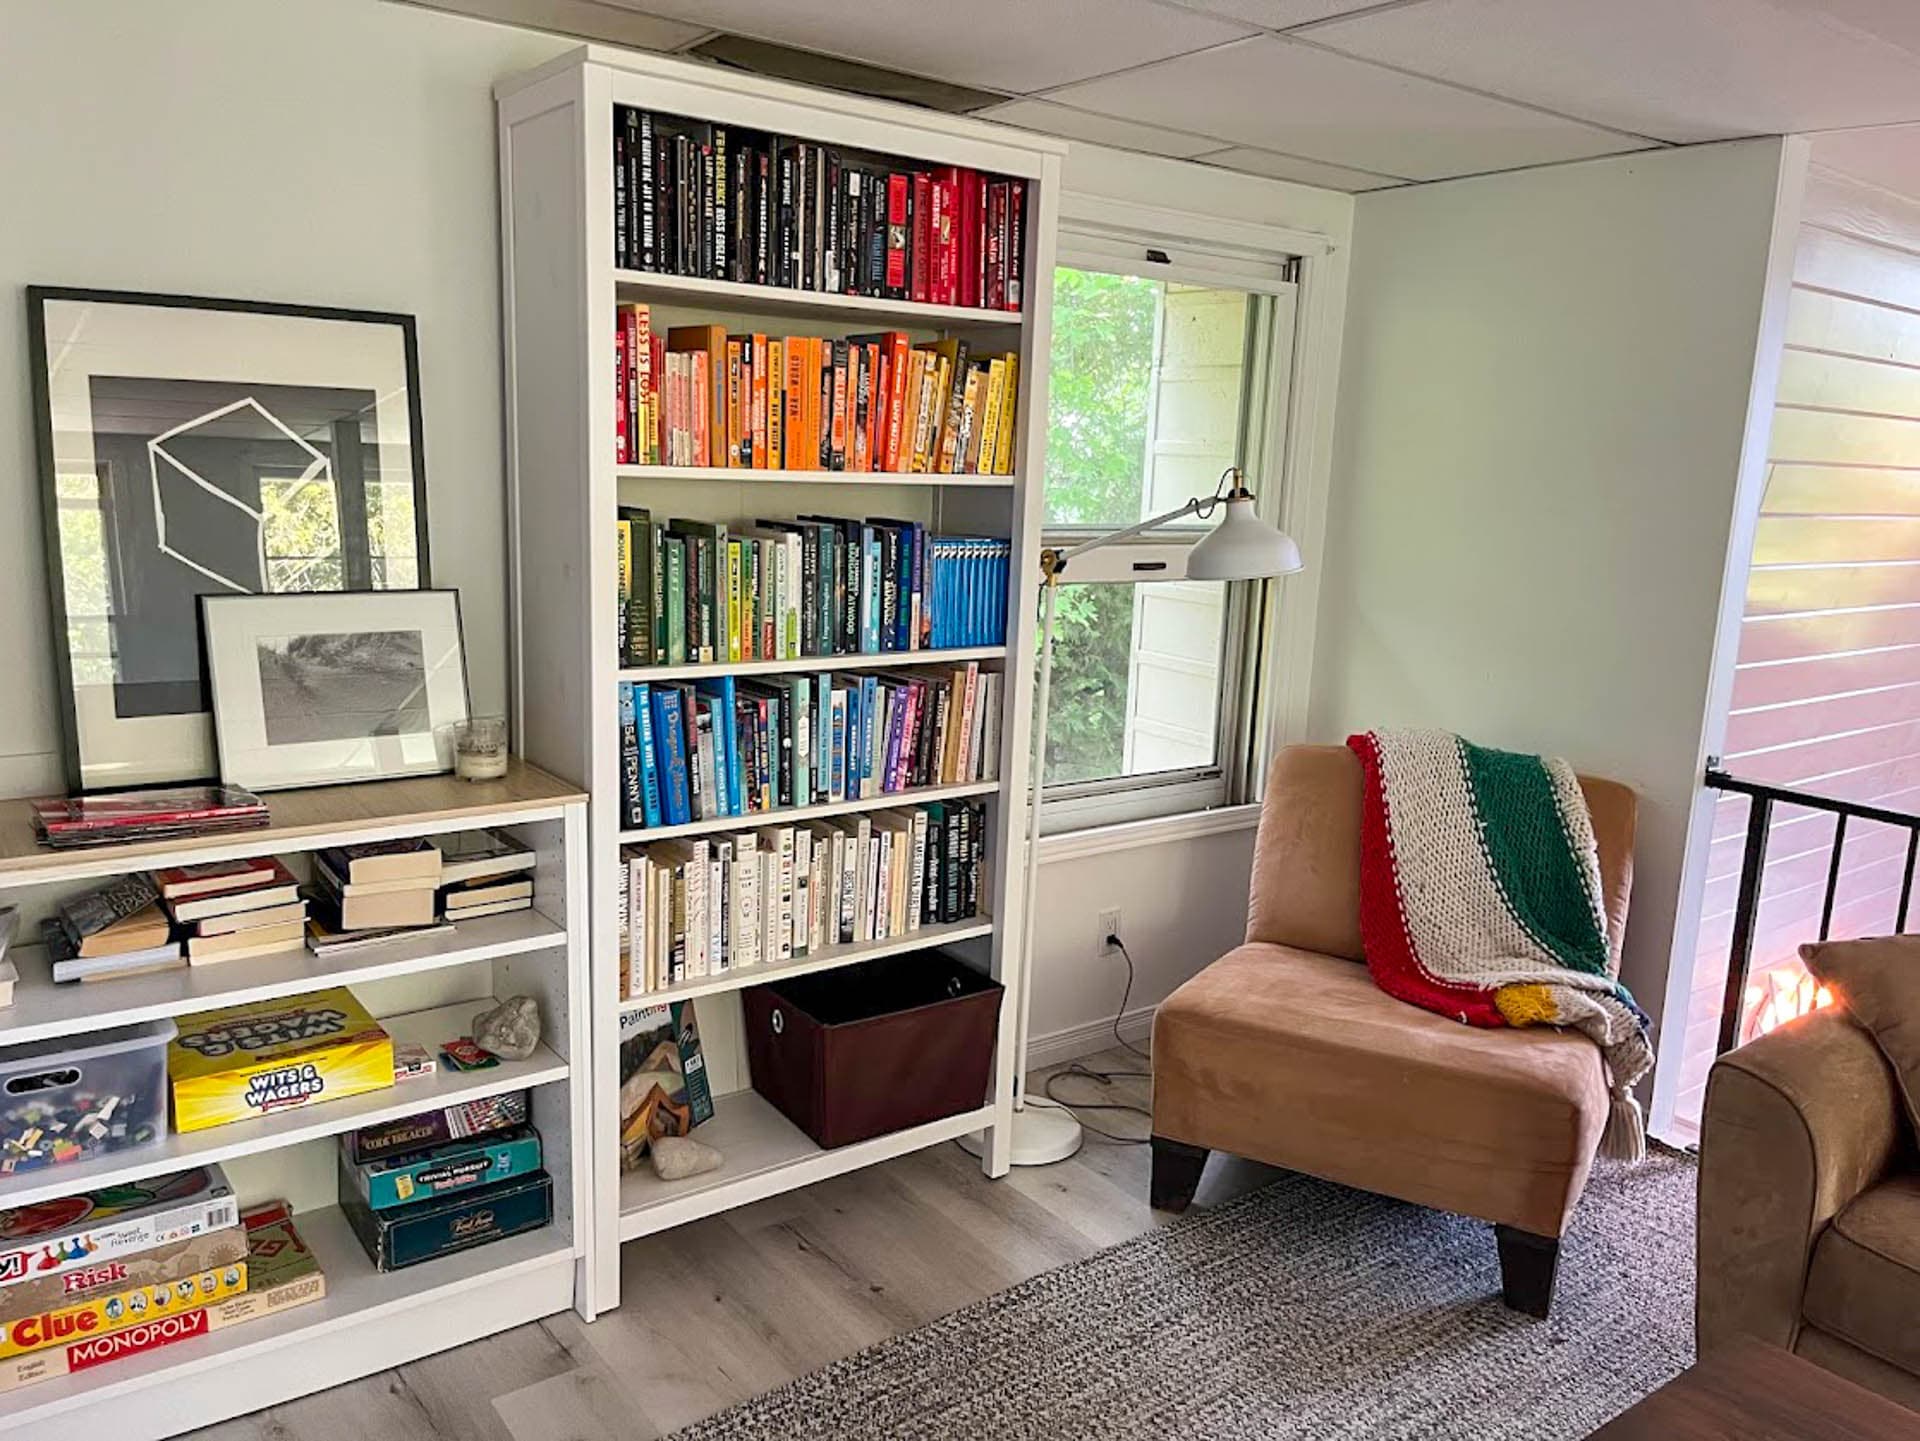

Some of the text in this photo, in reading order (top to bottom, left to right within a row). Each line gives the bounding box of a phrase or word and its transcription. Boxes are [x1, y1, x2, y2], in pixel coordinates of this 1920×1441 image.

[715, 207, 726, 232] ROSS
[638, 311, 651, 405] LESS IS LOST
[671, 546, 679, 592] TRUST
[846, 542, 856, 634] MARGARET ATWOOD
[640, 690, 649, 706] THE
[644, 744, 654, 769] WIVES
[626, 757, 640, 803] PENNY
[912, 840, 924, 888] AMERICAN
[619, 1003, 668, 1030] Painting
[246, 1079, 322, 1105] WAGERS
[249, 1065, 316, 1091] WITS &
[365, 1126, 434, 1151] CODE BREAKER
[418, 1168, 452, 1184] TRIVIAL
[452, 1160, 489, 1176] PURSUIT
[63, 1263, 128, 1294] Risk
[12, 1310, 99, 1347] Clue
[72, 1311, 203, 1365] MONOPOLY
